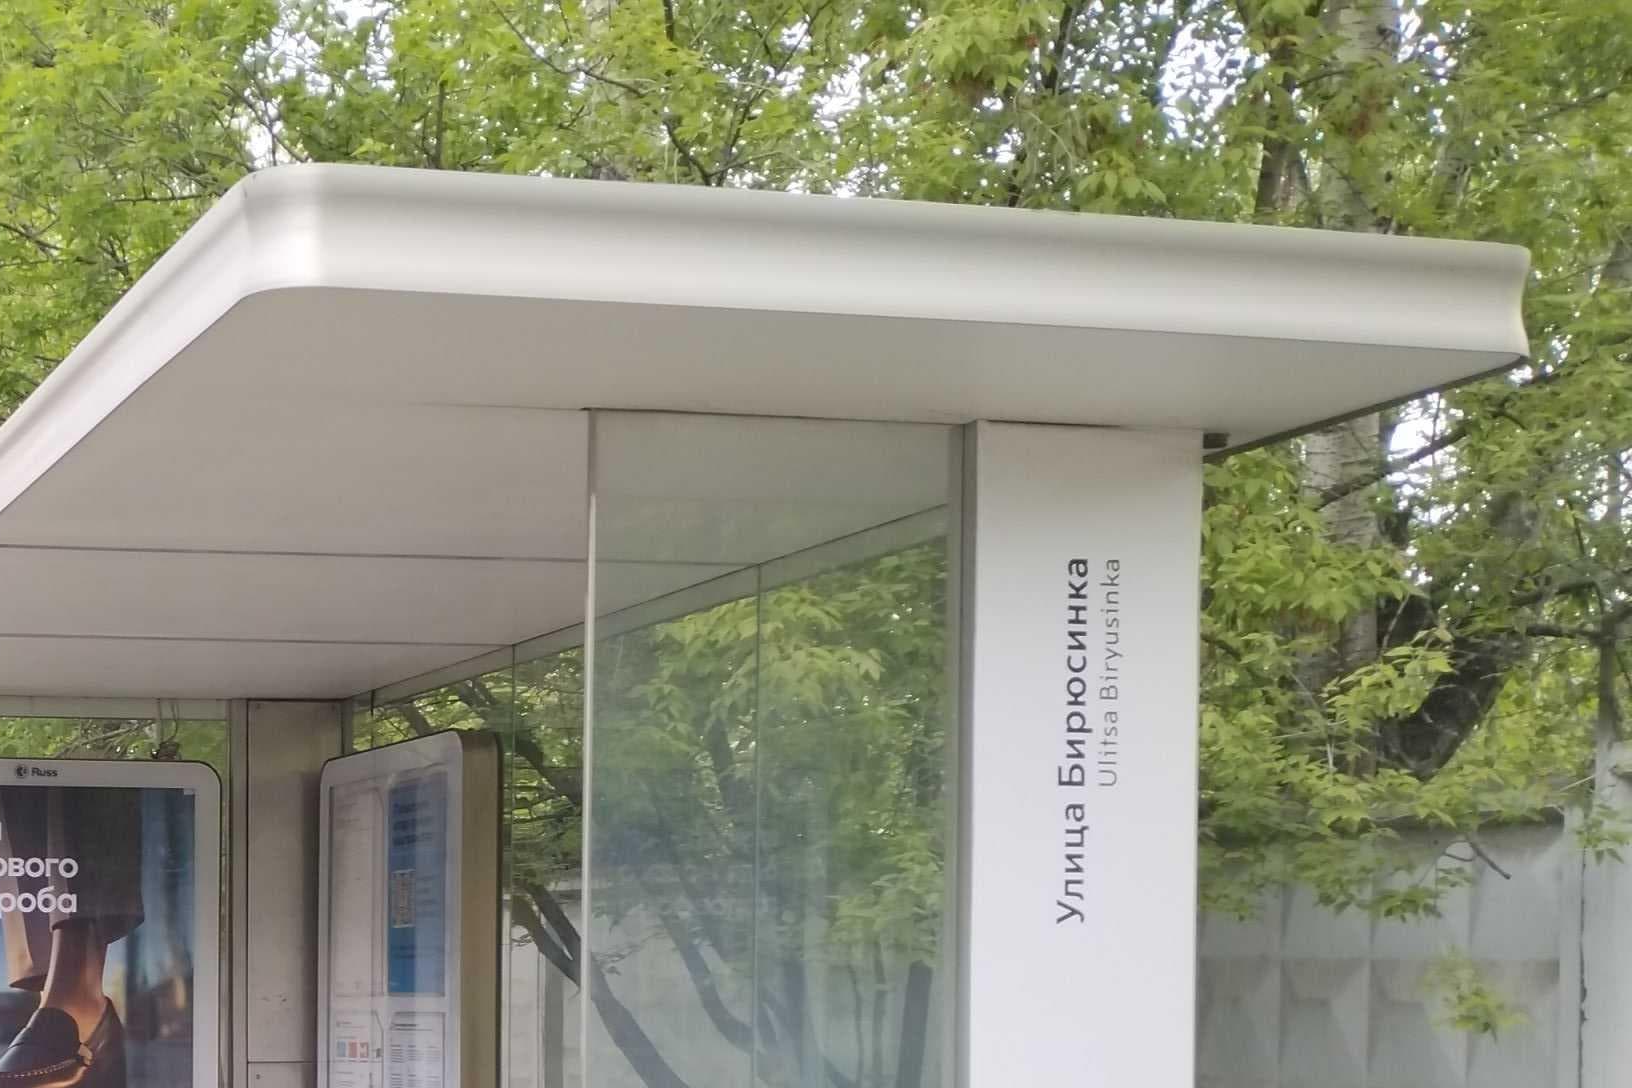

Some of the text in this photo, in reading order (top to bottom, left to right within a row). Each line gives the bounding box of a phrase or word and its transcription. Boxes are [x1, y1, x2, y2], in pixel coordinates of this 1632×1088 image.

[31, 767, 58, 777] Russ
[1056, 558, 1093, 924] Улица Бирюсинка
[1098, 558, 1123, 787] Ulitsa Biryusinka
